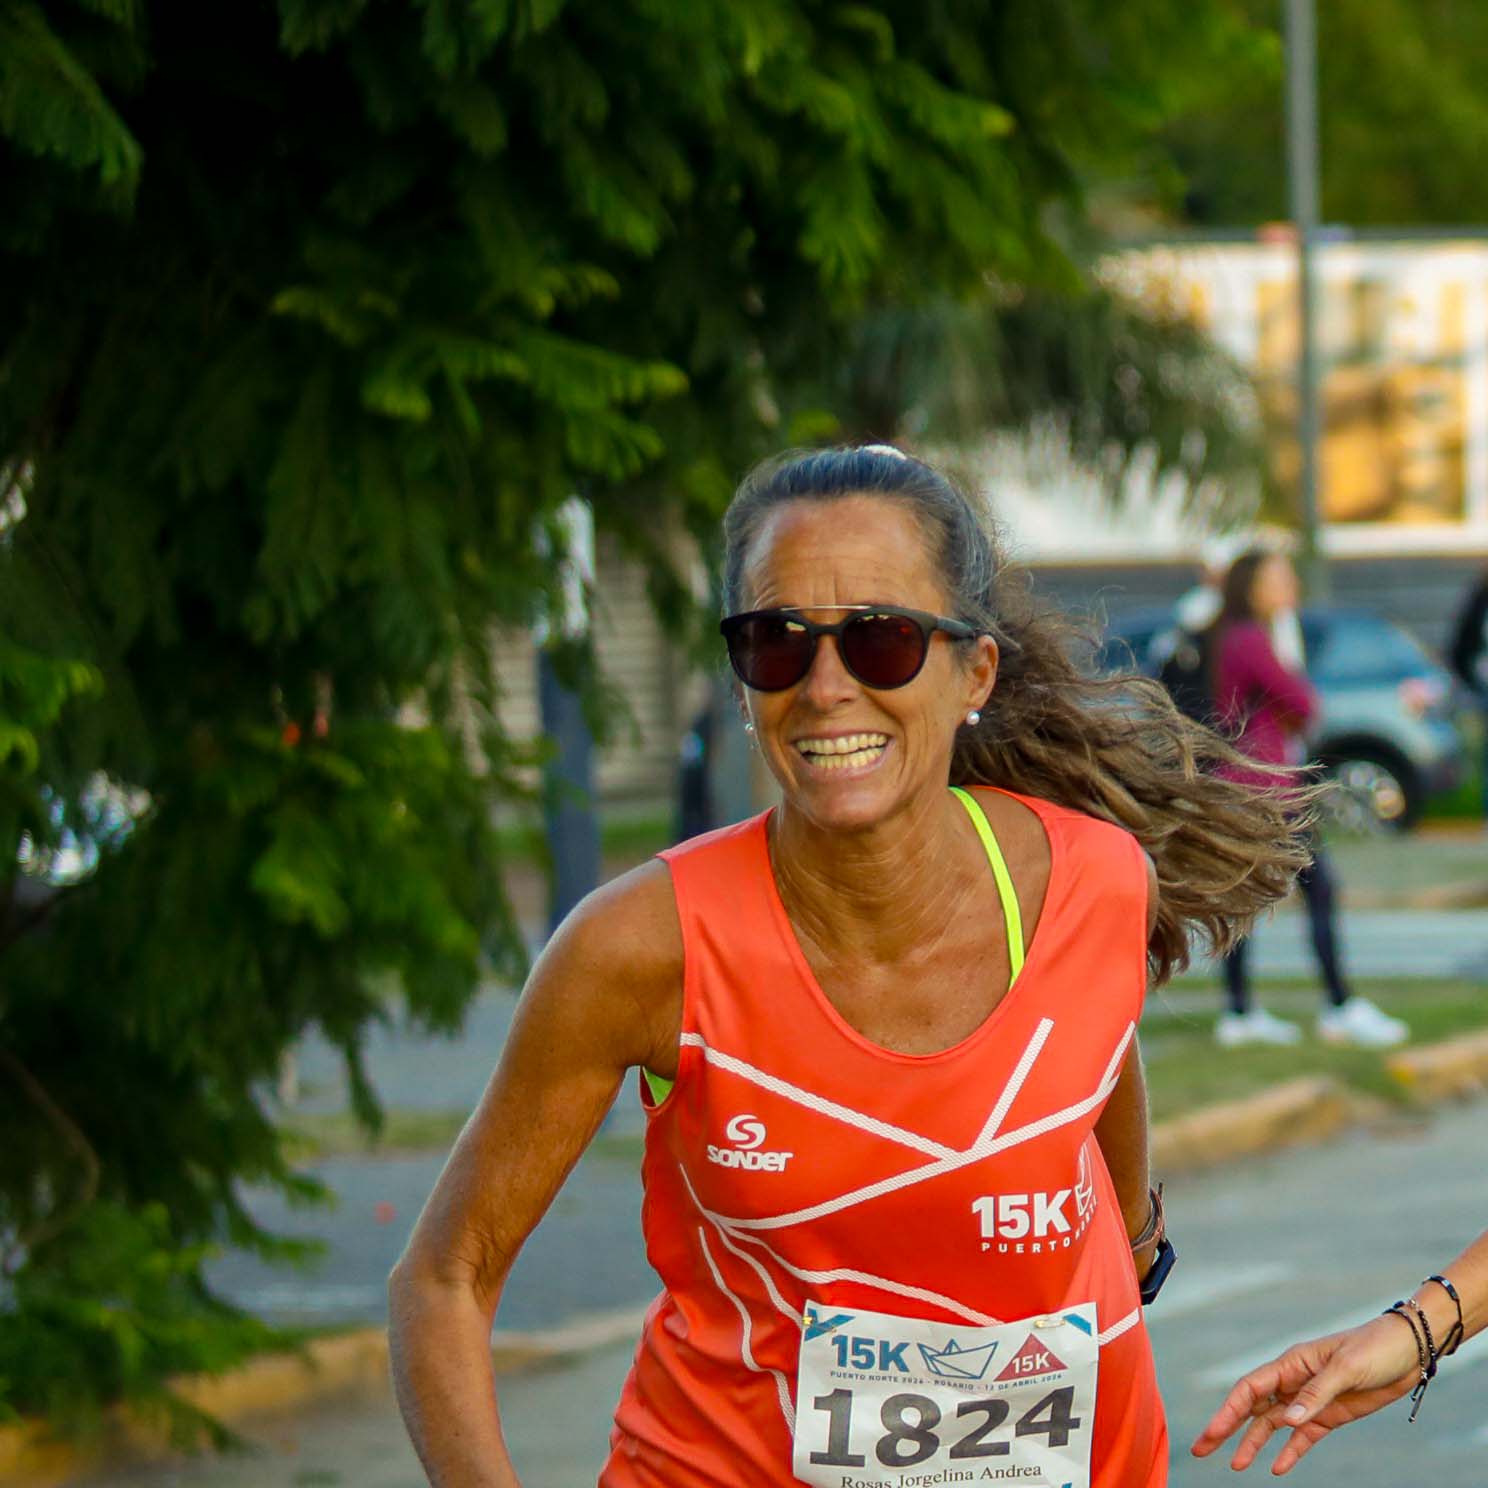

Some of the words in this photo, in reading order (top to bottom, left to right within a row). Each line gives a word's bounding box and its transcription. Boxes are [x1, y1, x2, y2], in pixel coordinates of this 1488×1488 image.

[971, 1189, 1073, 1239] 15K
[981, 1236, 1072, 1254] PUERTO
[831, 1334, 911, 1373] 15K
[1011, 1351, 1052, 1374] 15K
[830, 1370, 867, 1381] PUERTO
[868, 1374, 899, 1384] NORTE
[933, 1379, 974, 1391] ROSARIO
[1012, 1377, 1039, 1388] ABRIL
[809, 1386, 1081, 1468] 1824
[897, 1468, 974, 1488] Jorgelina
[979, 1464, 1042, 1480] Andrea
